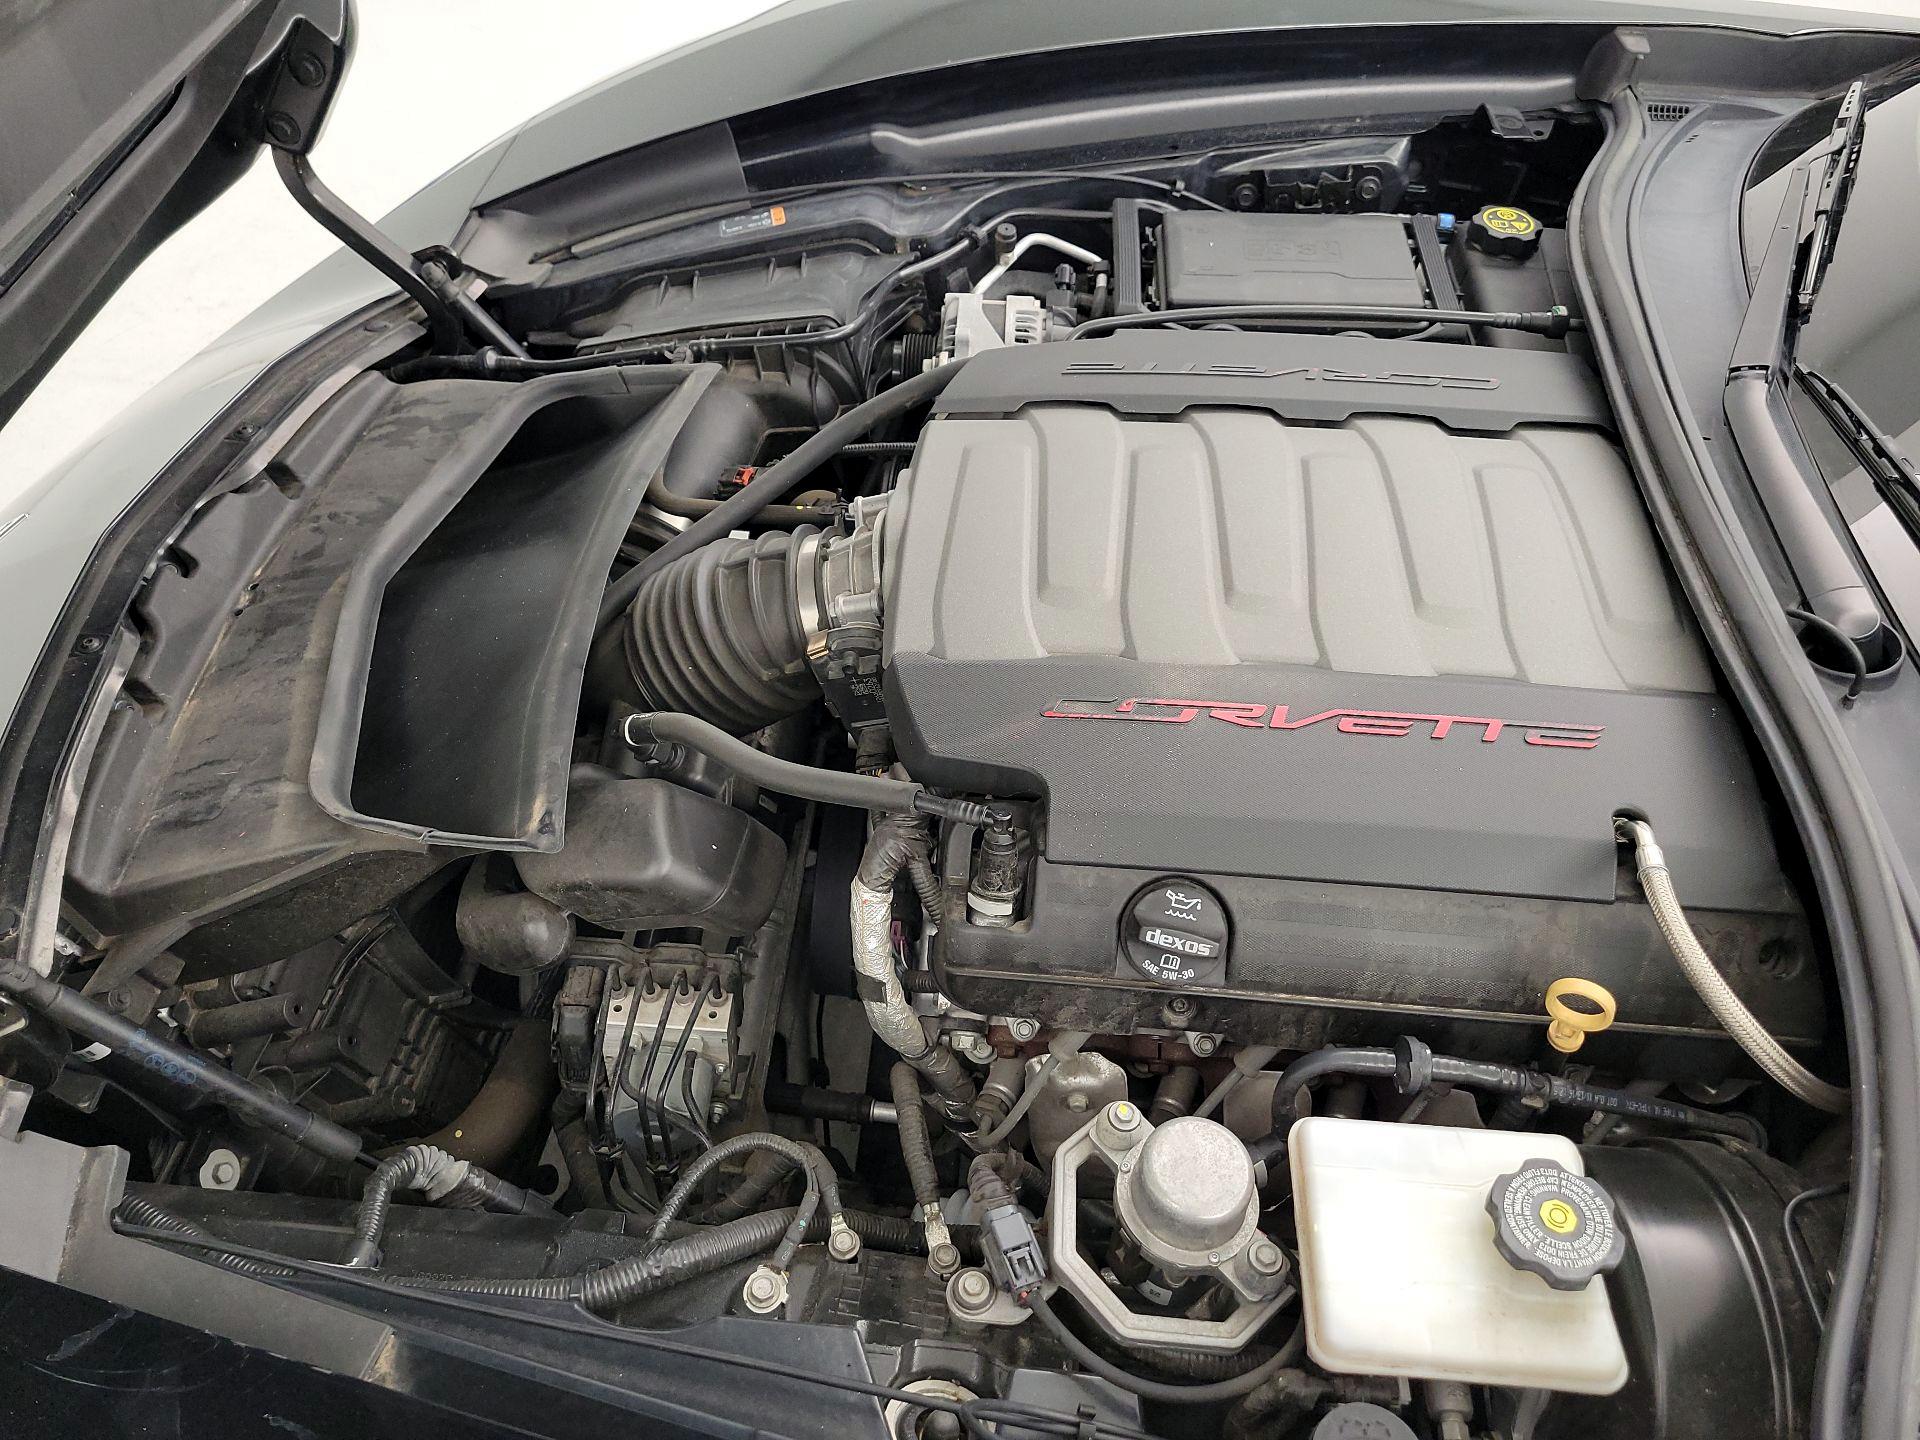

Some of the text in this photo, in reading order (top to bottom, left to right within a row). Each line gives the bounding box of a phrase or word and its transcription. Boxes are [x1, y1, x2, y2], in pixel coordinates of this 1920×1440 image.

[1040, 697, 1606, 748] CORVETTE
[1145, 929, 1214, 956] dexos
[1142, 959, 1195, 980] SAE 5W-30
[1540, 1168, 1558, 1177] DOT3
[1547, 1177, 1559, 1185] CAP
[1560, 1172, 1594, 1197] ATTENTION:
[1522, 1196, 1533, 1215] CLEAN
[1515, 1216, 1527, 1229] USE
[1524, 1216, 1543, 1239] FILLER
[1523, 1228, 1540, 1243] ONLY
[1539, 1242, 1556, 1255] DOT3
